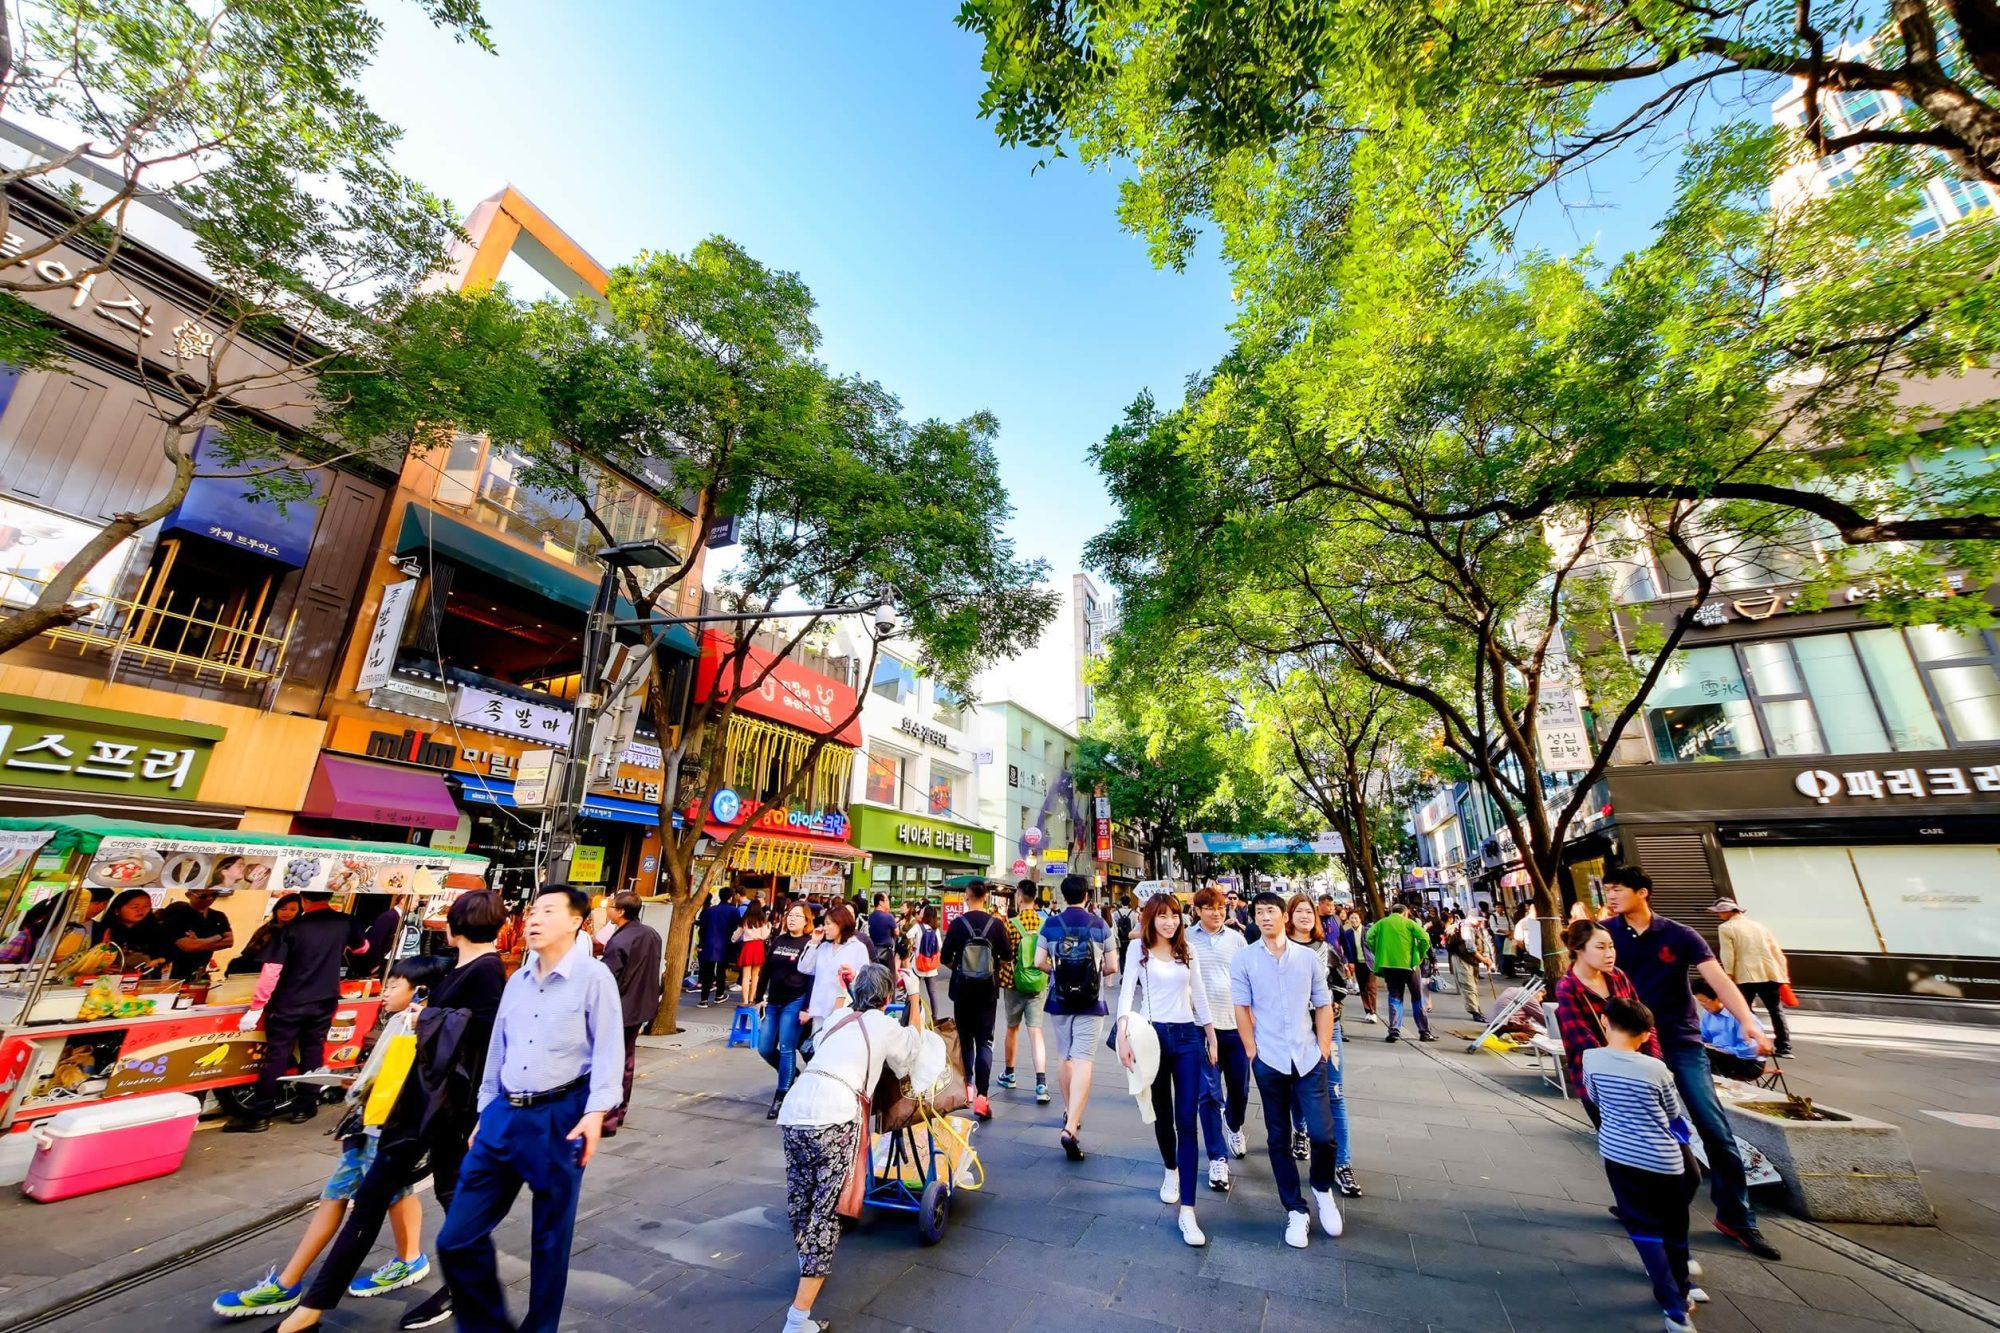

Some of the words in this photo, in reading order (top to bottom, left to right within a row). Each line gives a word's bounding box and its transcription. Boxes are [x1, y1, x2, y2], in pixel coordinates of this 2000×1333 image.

[209, 526, 234, 541] 카페
[484, 700, 573, 735] 족발마
[1547, 733, 1577, 745] 성심
[0, 724, 196, 790] 스프리
[1549, 746, 1581, 758] 필방
[898, 824, 932, 847] 네이처
[935, 829, 973, 853] 리퍼블릭
[110, 839, 147, 850] crepes
[181, 844, 217, 854] crepes
[247, 848, 278, 857] crepes
[304, 851, 333, 859] crepes
[945, 905, 964, 913] SALE
[189, 1031, 241, 1044] crepes
[117, 1075, 167, 1088] blueberry
